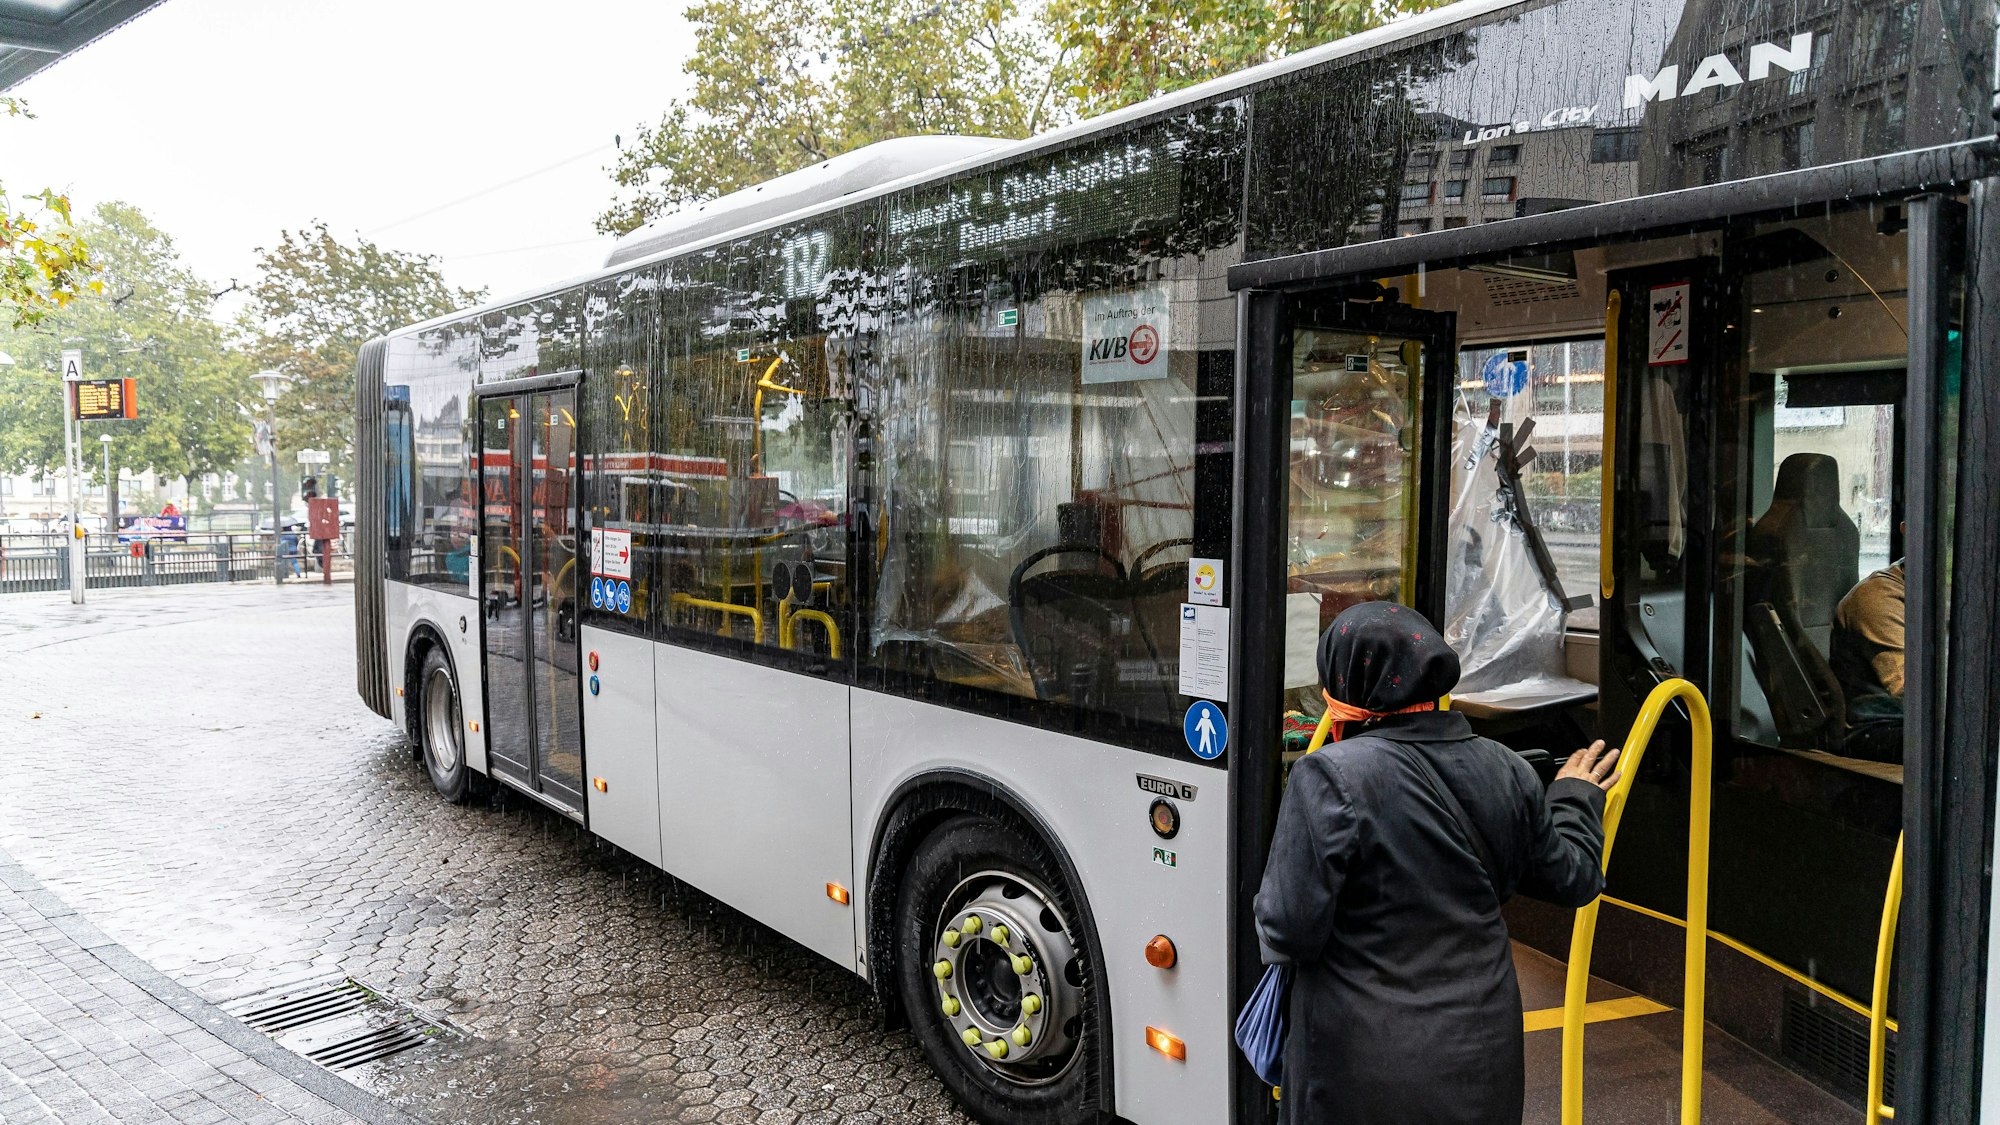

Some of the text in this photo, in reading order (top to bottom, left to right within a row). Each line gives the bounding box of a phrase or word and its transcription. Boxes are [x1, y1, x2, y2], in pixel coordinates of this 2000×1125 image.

[1624, 32, 1812, 109] MAN
[1463, 104, 1598, 145] Lion's City
[783, 232, 827, 299] 132
[1107, 308, 1138, 319] Auftrag
[1141, 306, 1156, 316] der
[1090, 336, 1128, 360] KVB
[66, 360, 78, 377] A
[1140, 777, 1192, 799] EURO 6
